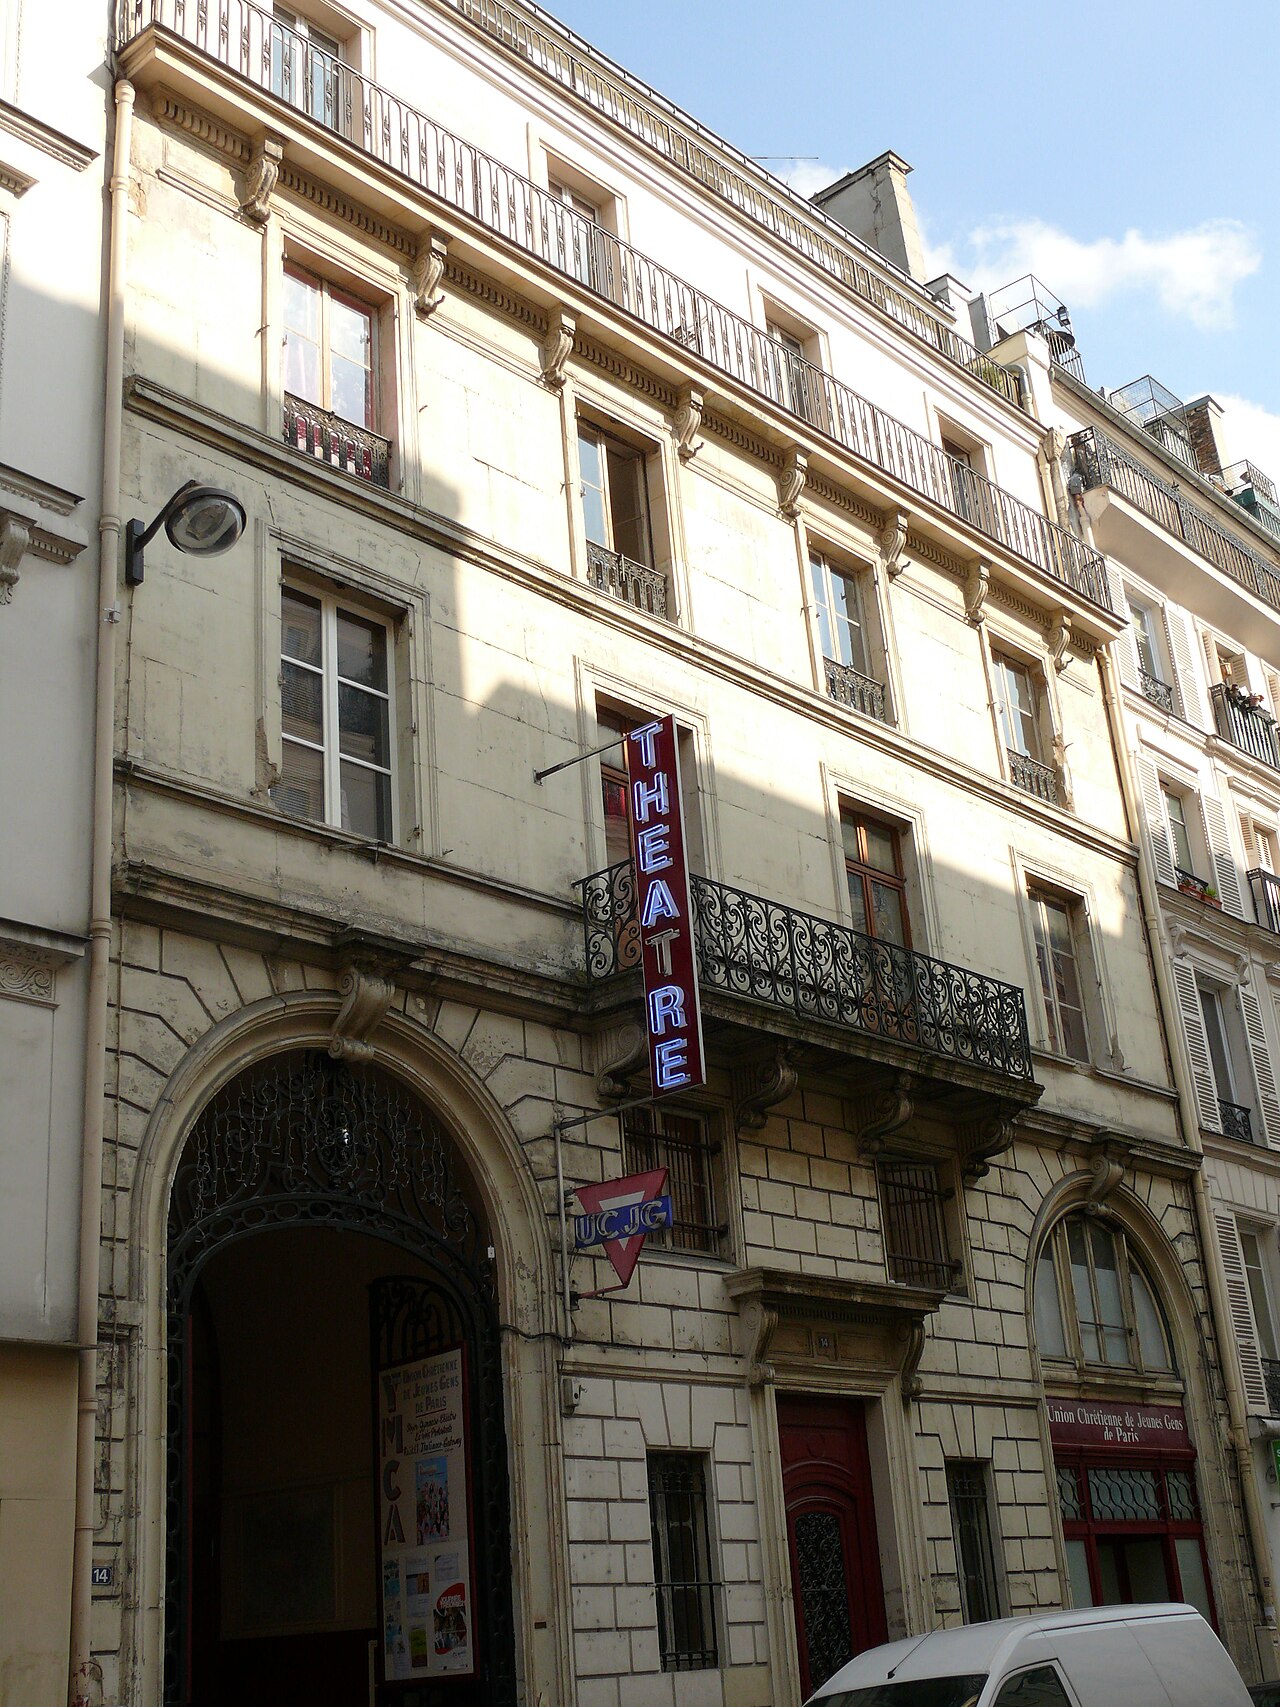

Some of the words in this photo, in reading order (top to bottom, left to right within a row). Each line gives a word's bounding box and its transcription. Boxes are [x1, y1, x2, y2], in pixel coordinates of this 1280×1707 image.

[630, 722, 692, 1090] THEATRE
[1046, 1405, 1075, 1423] Union
[1077, 1407, 1123, 1427] Chrétienne
[1125, 1411, 1134, 1428] de
[1137, 1412, 1163, 1429] Jeunes
[1165, 1414, 1184, 1431] Gens
[1103, 1426, 1114, 1441] de
[1116, 1428, 1140, 1443] Paris
[94, 1569, 108, 1582] 14
